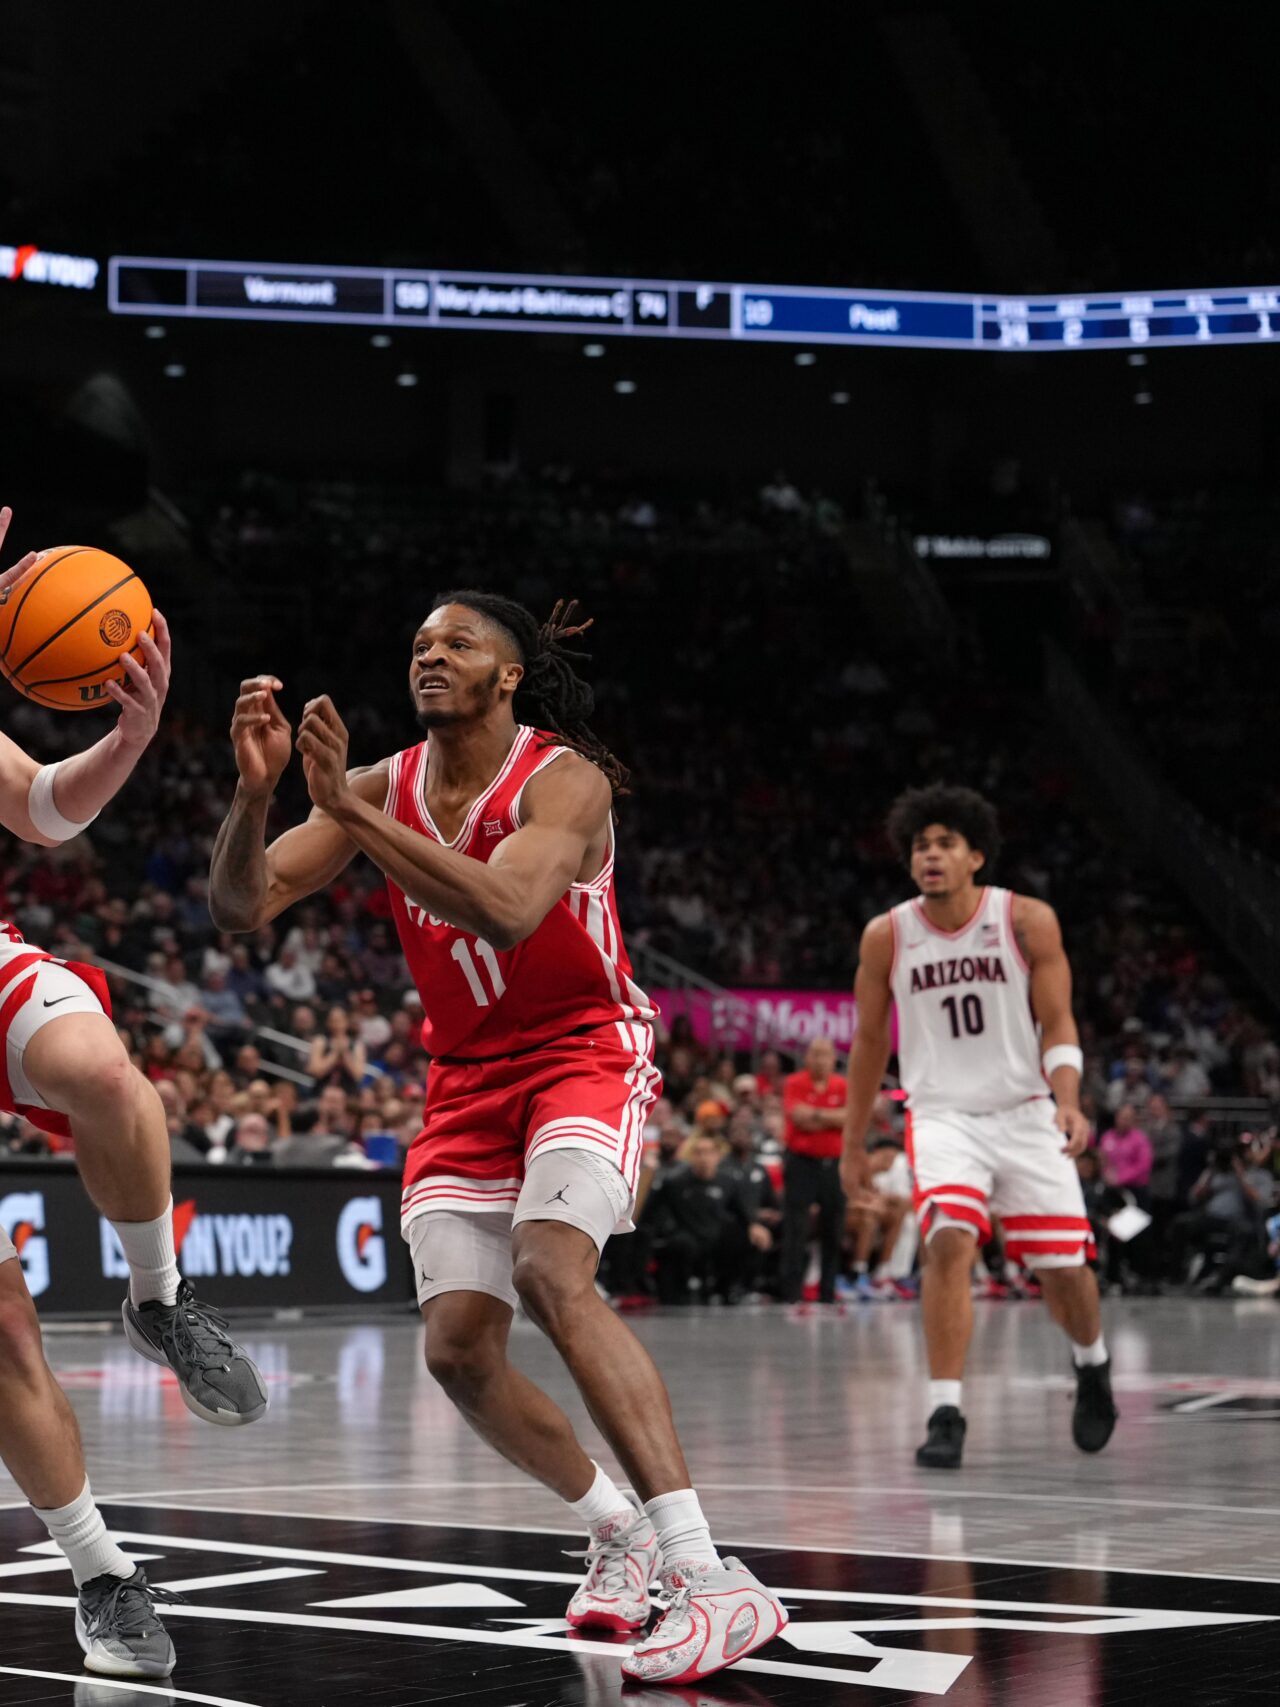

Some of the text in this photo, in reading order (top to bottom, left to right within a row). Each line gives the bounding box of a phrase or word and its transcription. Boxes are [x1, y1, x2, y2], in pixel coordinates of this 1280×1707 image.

[244, 276, 336, 305] Vermont
[450, 937, 507, 1007] 11
[910, 957, 1008, 993] ARIZONA
[941, 994, 985, 1039] 10
[336, 1197, 388, 1293] G
